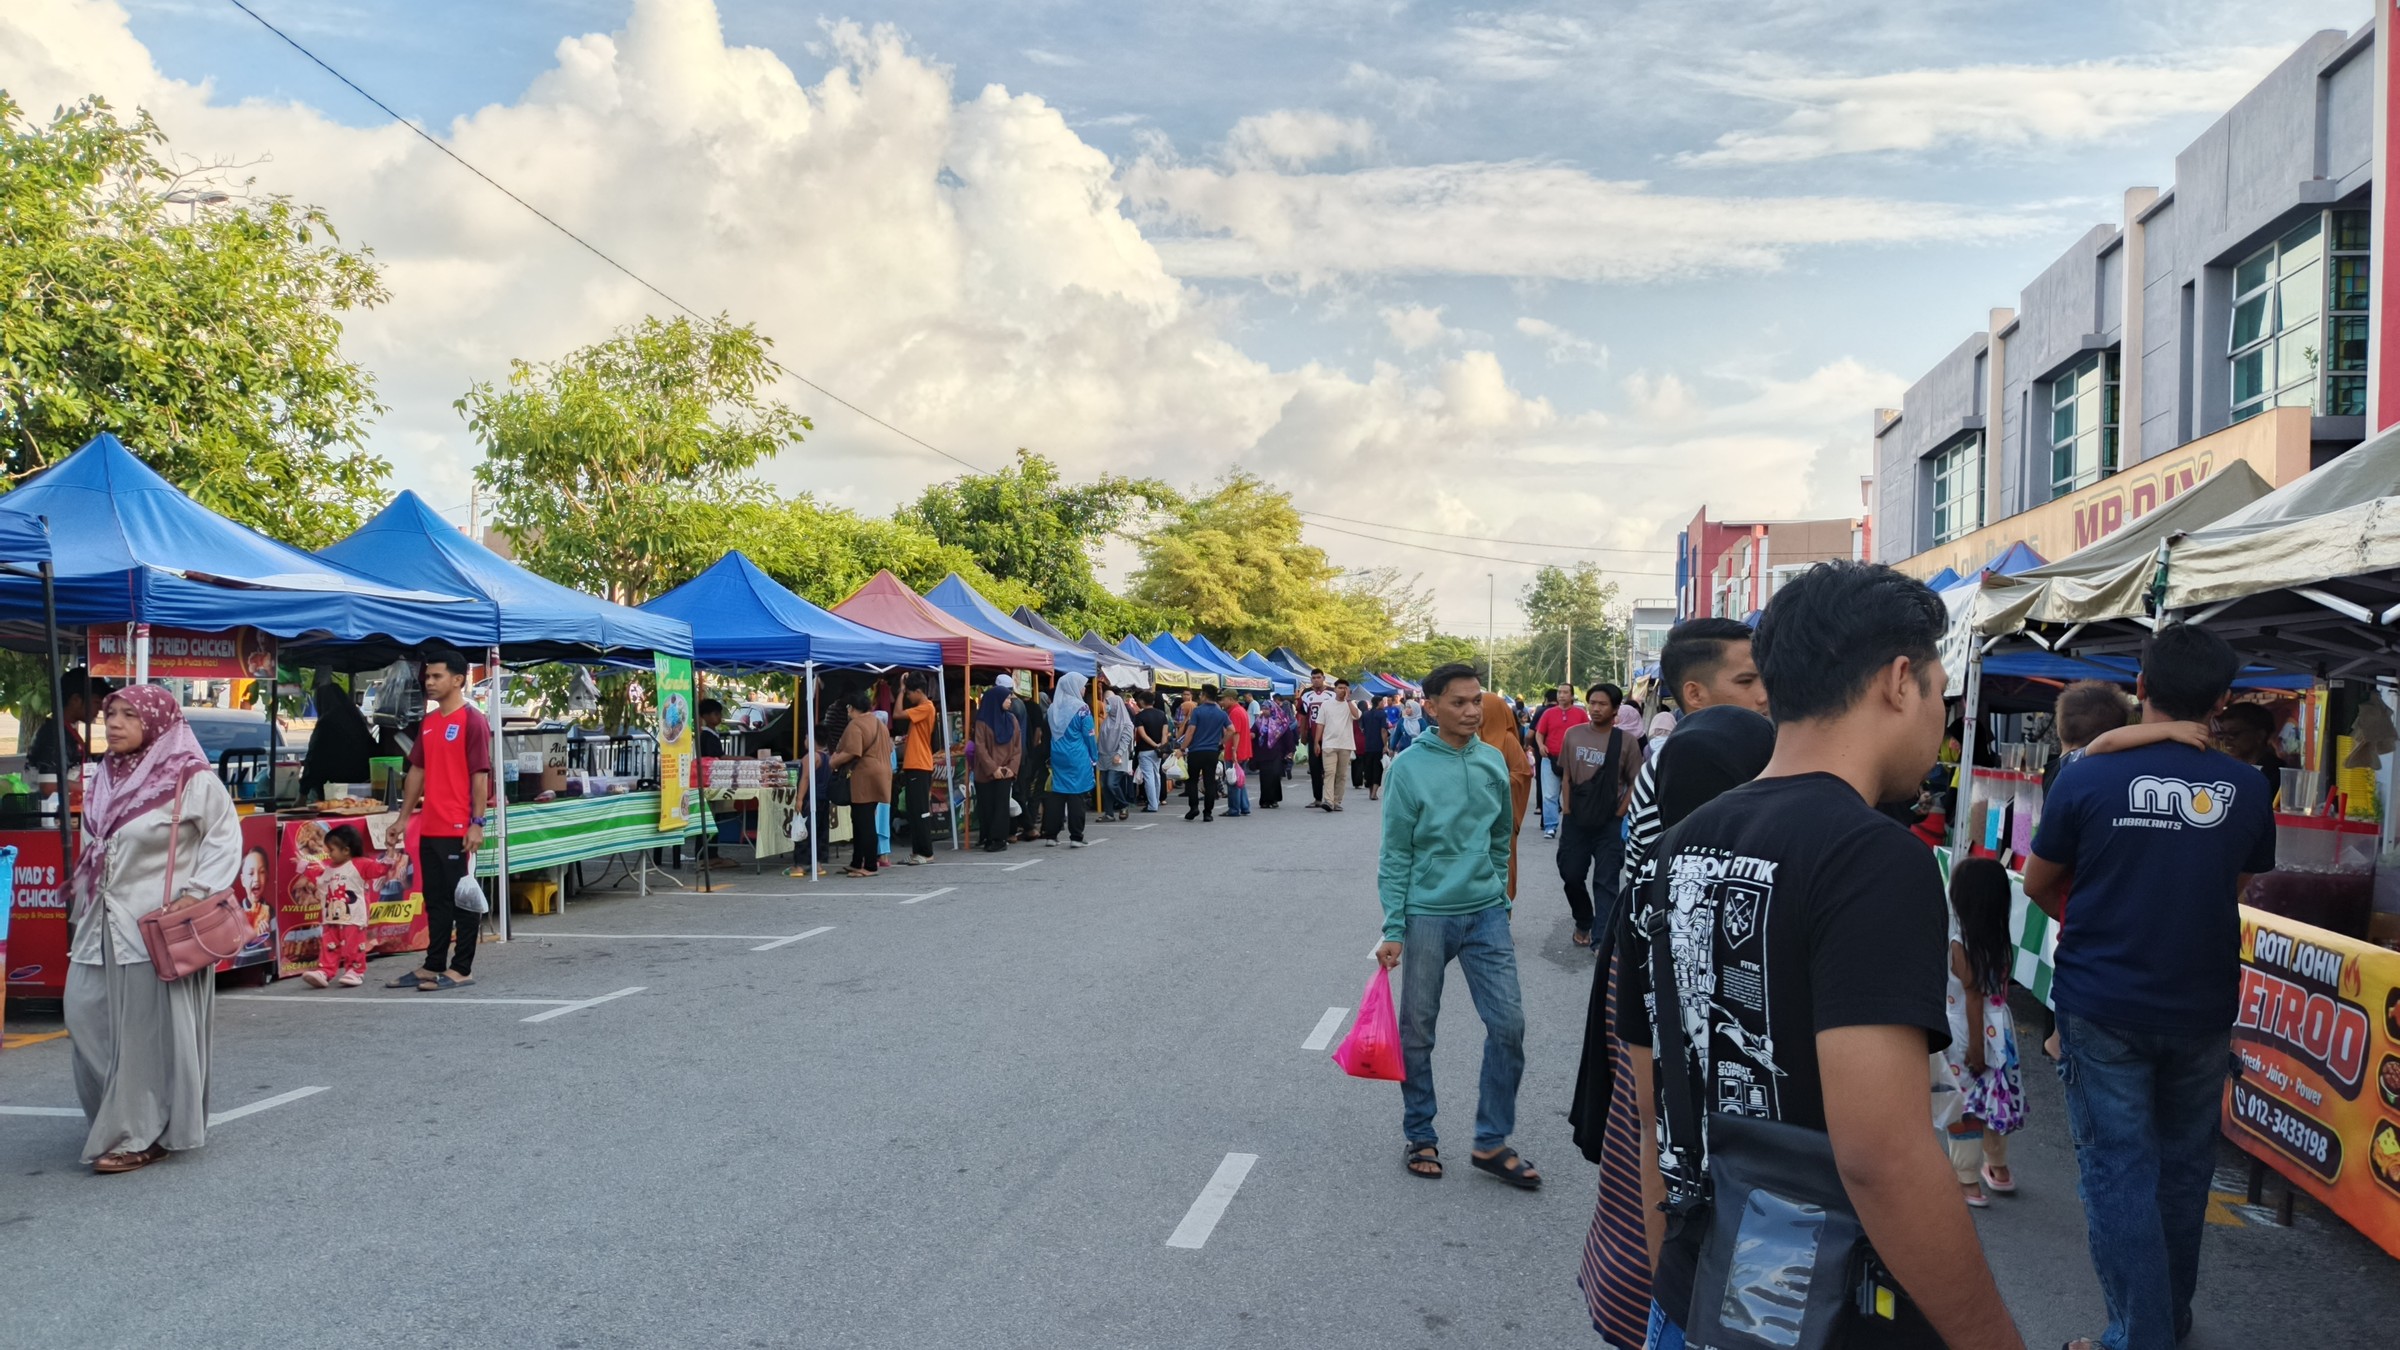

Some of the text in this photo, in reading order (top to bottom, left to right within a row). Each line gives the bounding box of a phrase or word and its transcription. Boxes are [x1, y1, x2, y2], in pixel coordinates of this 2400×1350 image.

[99, 638, 117, 653] MR
[156, 638, 188, 656] FRIED
[191, 640, 235, 657] CHICKEN
[2112, 817, 2182, 831] LUBRICANTS
[14, 866, 56, 886] IVAD'S
[1729, 856, 1779, 884] FITIK
[17, 888, 67, 908] CHICK
[1740, 960, 1761, 973] FITIK
[2255, 929, 2341, 987] ROTI JOHN
[1717, 1061, 1752, 1075] COMBAT
[2241, 1048, 2322, 1106] Fresh Juicy Power
[2248, 1093, 2329, 1164] 012-3433198
